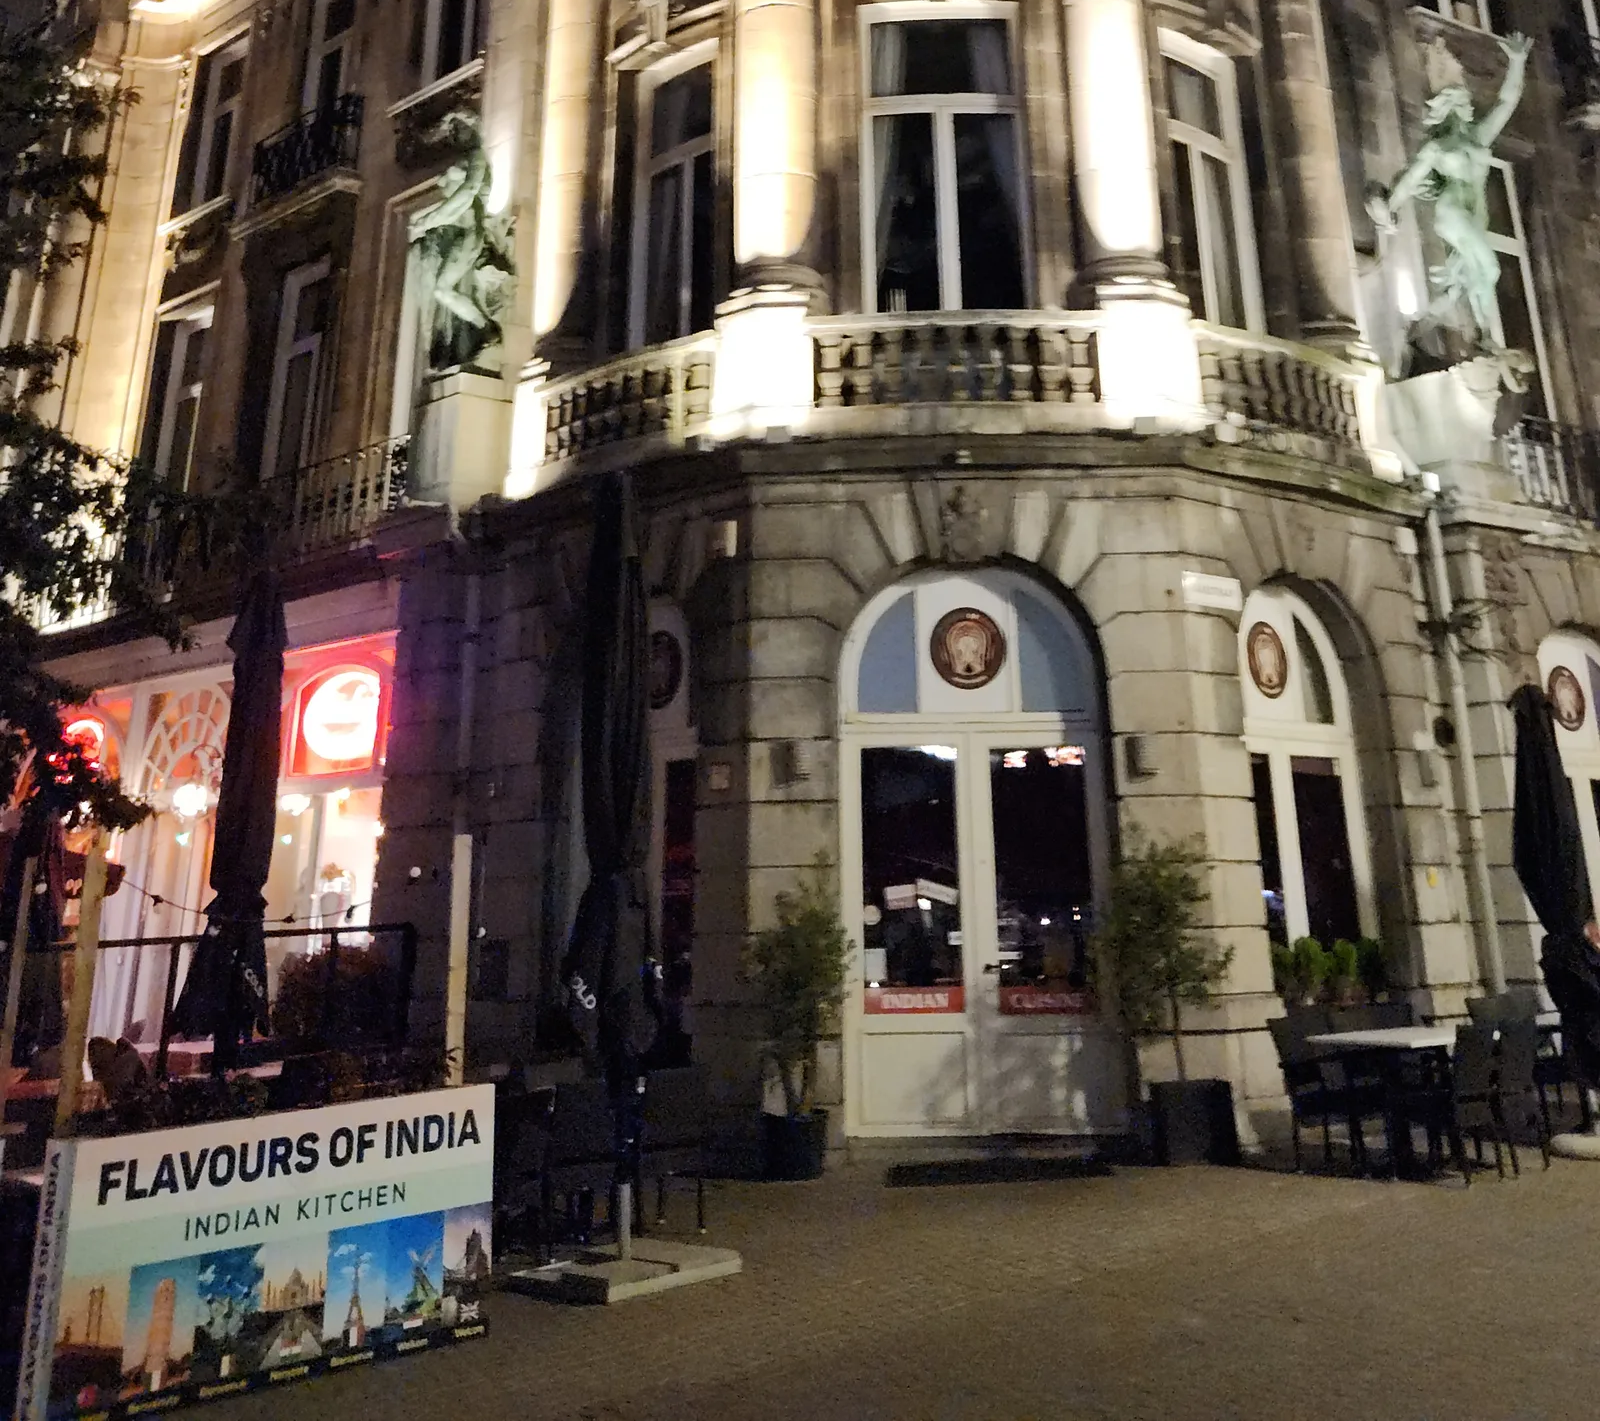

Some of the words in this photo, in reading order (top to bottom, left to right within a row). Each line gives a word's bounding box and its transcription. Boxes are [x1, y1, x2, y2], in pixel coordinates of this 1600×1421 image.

[880, 992, 950, 1010] INDIAN
[97, 1131, 320, 1206] FLAVOURS
[328, 1123, 378, 1168] OF
[384, 1109, 481, 1159] INDIA
[184, 1203, 281, 1242] INDIAN
[296, 1181, 406, 1221] KITCHEN
